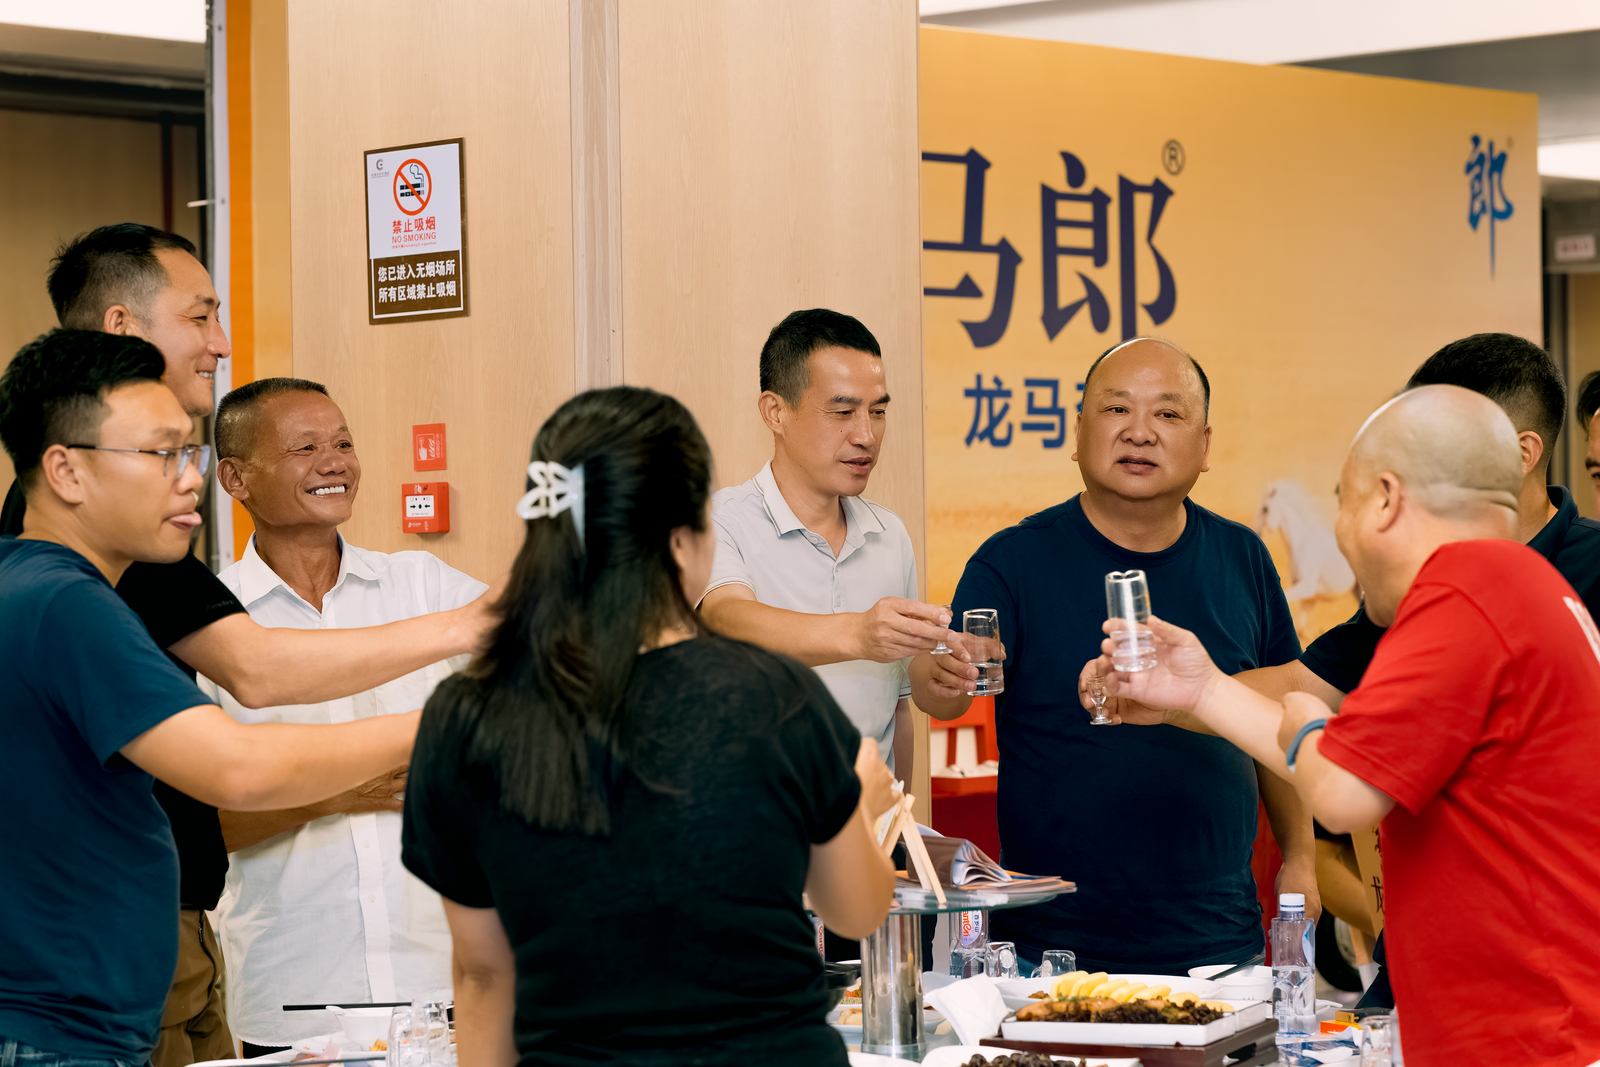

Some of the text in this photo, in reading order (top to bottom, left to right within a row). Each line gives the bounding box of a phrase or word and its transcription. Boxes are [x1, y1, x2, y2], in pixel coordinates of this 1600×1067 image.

[392, 216, 436, 234] 禁止吸烟
[392, 232, 436, 244] NO SMOKING
[378, 259, 455, 283] 您已进入无烟场所
[378, 281, 456, 303] 所有区域禁止吸烟
[964, 373, 1085, 448] 龙马
